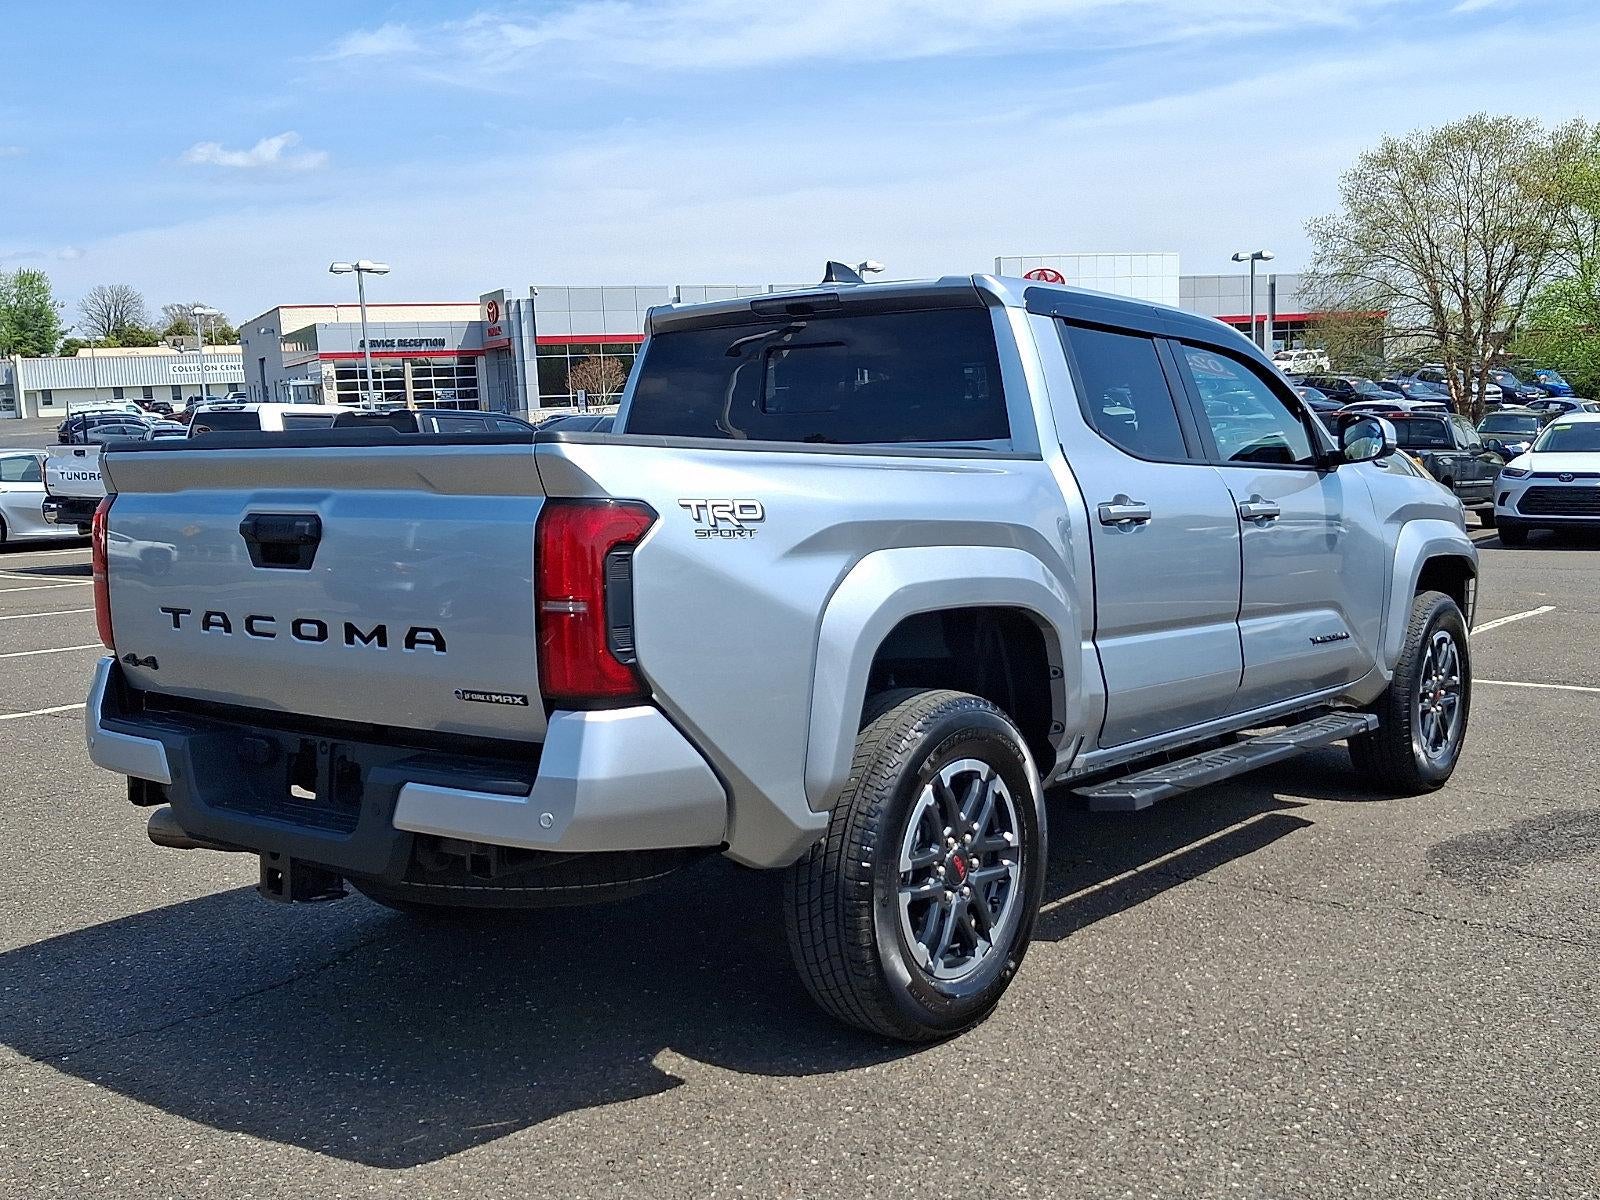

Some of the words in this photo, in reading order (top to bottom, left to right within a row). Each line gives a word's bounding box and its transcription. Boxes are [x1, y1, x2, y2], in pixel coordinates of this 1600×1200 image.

[360, 339, 396, 348] SERVICE
[398, 338, 446, 347] RECEPTION
[172, 365, 218, 373] COLLISON
[678, 499, 765, 527] TRD
[694, 529, 758, 539] SPORT
[159, 606, 448, 655] TACOMA
